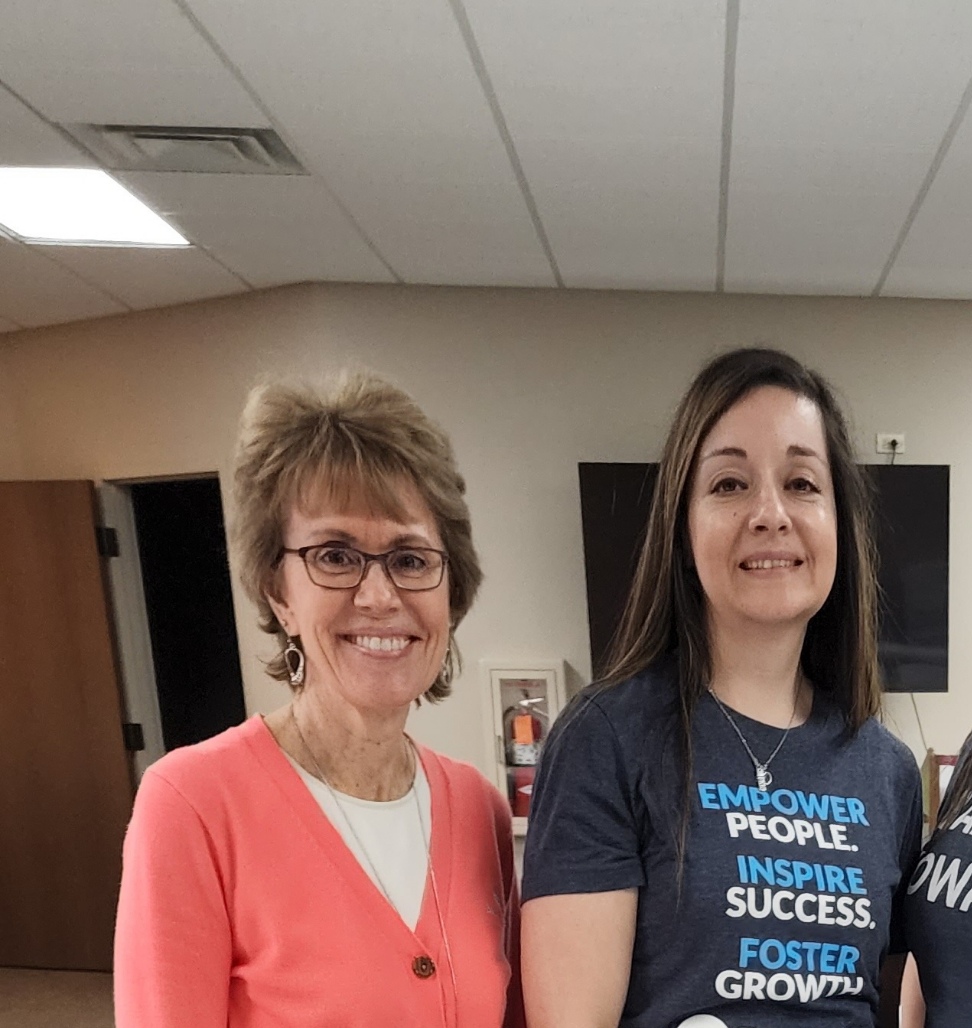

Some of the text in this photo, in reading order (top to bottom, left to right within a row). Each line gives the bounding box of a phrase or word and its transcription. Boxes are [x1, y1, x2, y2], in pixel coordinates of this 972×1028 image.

[698, 783, 870, 827] EMPOWER
[726, 813, 859, 852] PEOPLE.
[736, 855, 867, 895] INSPIRE
[725, 887, 877, 930] SUCCESS.
[738, 938, 860, 974] FOSTER
